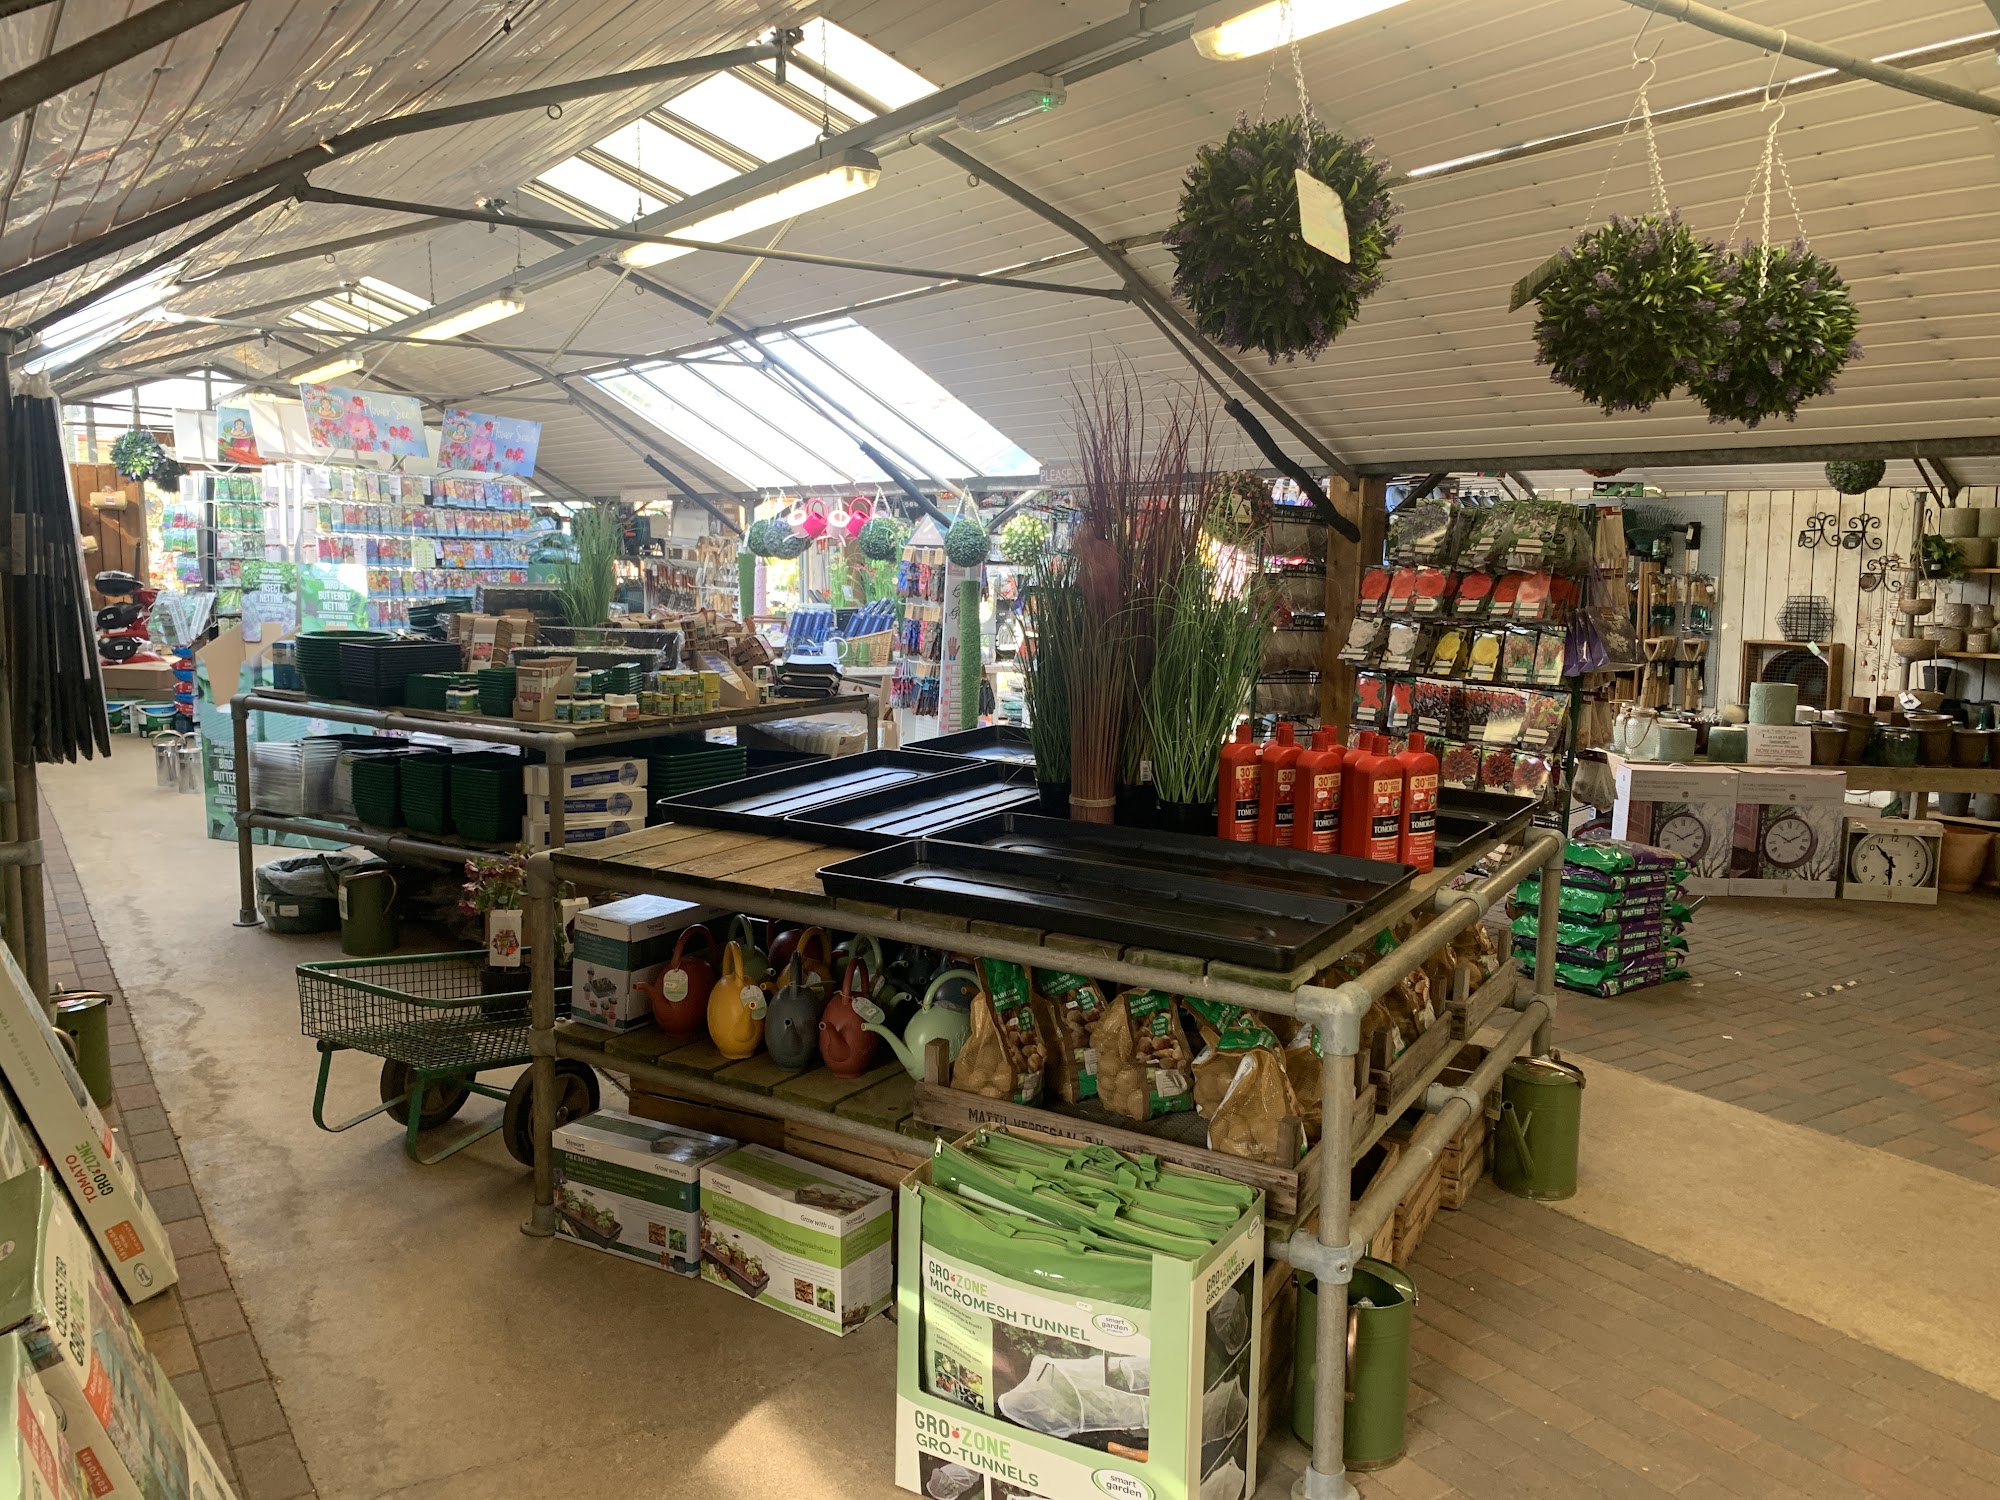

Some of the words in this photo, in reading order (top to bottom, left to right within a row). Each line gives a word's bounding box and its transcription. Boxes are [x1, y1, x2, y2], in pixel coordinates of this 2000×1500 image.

[1040, 468, 1072, 482] PLEASE
[260, 584, 281, 592] INSECT
[260, 593, 283, 604] NETTING
[318, 591, 351, 601] BUTTERFLY
[323, 602, 348, 612] NETTING
[219, 758, 234, 770] BIRD
[1374, 824, 1398, 834] TOMORITE
[1623, 946, 1634, 954] PEAT
[1634, 944, 1645, 952] FREE
[1623, 980, 1634, 988] PEAT
[565, 1139, 585, 1149] Stewart
[75, 1141, 101, 1172] ZONE
[566, 1152, 598, 1166] PREMIUM
[654, 1164, 668, 1172] Grow
[66, 1154, 98, 1204] TOMATO
[94, 1174, 114, 1196] GRO
[712, 1178, 730, 1191] Stewart
[800, 1214, 814, 1224] Grow
[815, 1219, 827, 1229] with
[846, 1212, 865, 1226] Stewart
[56, 1256, 67, 1281] TIER
[1206, 1270, 1219, 1292] GRO
[1224, 1250, 1238, 1277] ZONE
[929, 1260, 949, 1281] GRO
[956, 1275, 988, 1297] ZONE
[1206, 1258, 1245, 1304] GRO-TUNNELS
[56, 1286, 67, 1337] CLASSIC
[930, 1276, 1017, 1322] MICROMESH
[1021, 1313, 1090, 1341] TUNNEL
[1101, 1322, 1128, 1332] garden
[1105, 1316, 1124, 1325] smart
[70, 1319, 84, 1367] GRO
[915, 1410, 950, 1438] GRO
[960, 1427, 1012, 1461] ZONE
[916, 1432, 1039, 1487] GRO-TUNNELS
[1110, 1474, 1136, 1488] smart
[1106, 1481, 1142, 1498] garden
